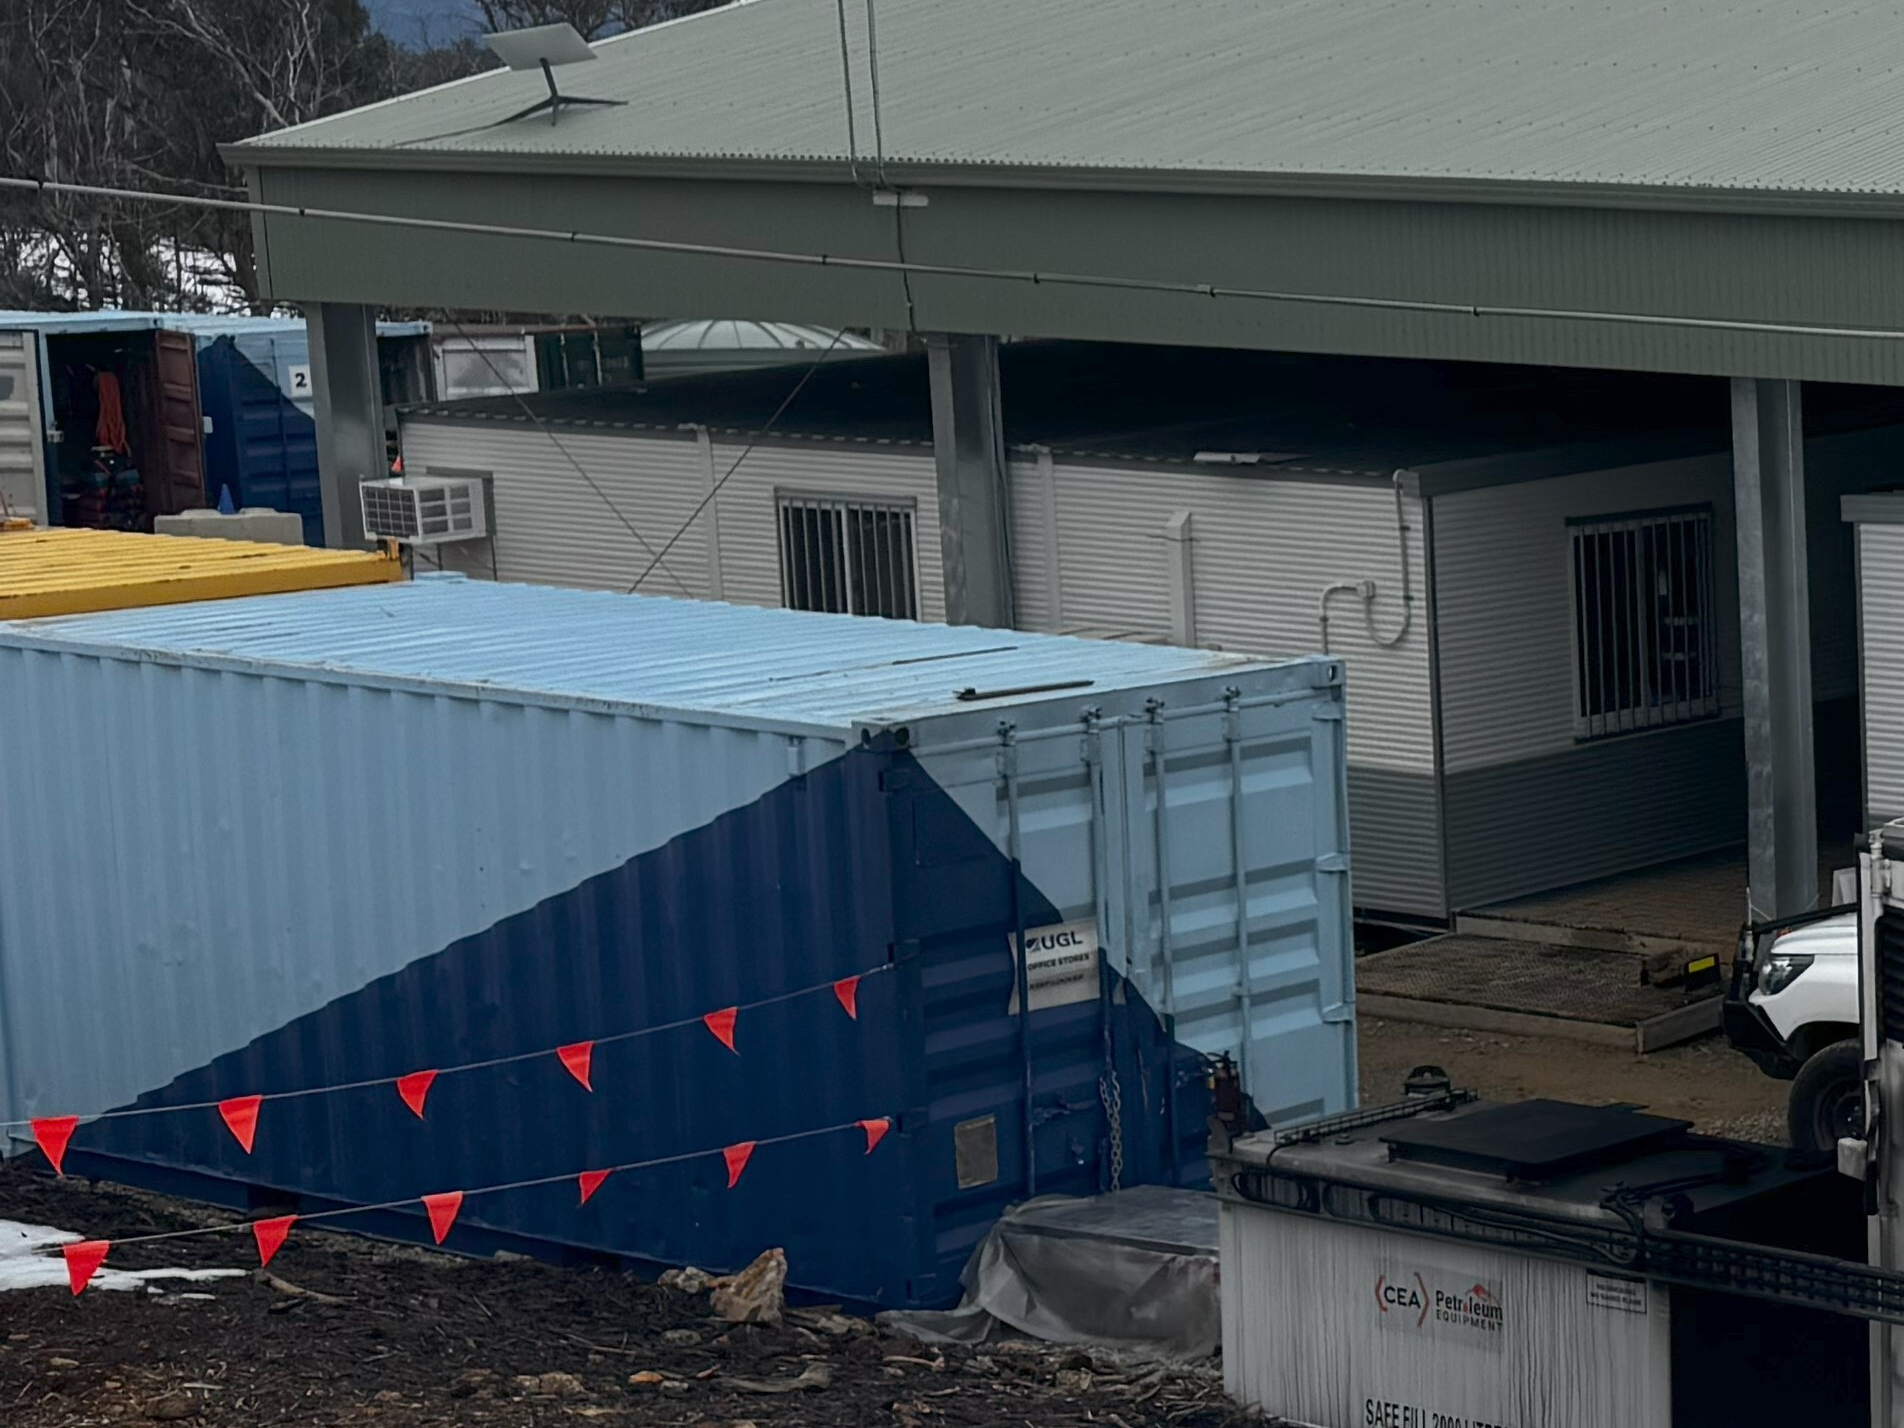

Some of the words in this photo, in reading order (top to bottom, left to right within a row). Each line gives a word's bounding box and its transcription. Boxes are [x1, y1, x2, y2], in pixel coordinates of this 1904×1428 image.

[295, 372, 307, 388] 2
[1041, 930, 1083, 950] UGL
[1028, 959, 1056, 971] OFFICE
[1383, 1285, 1421, 1309] CEA
[1436, 1309, 1503, 1332] EQUIPMENT
